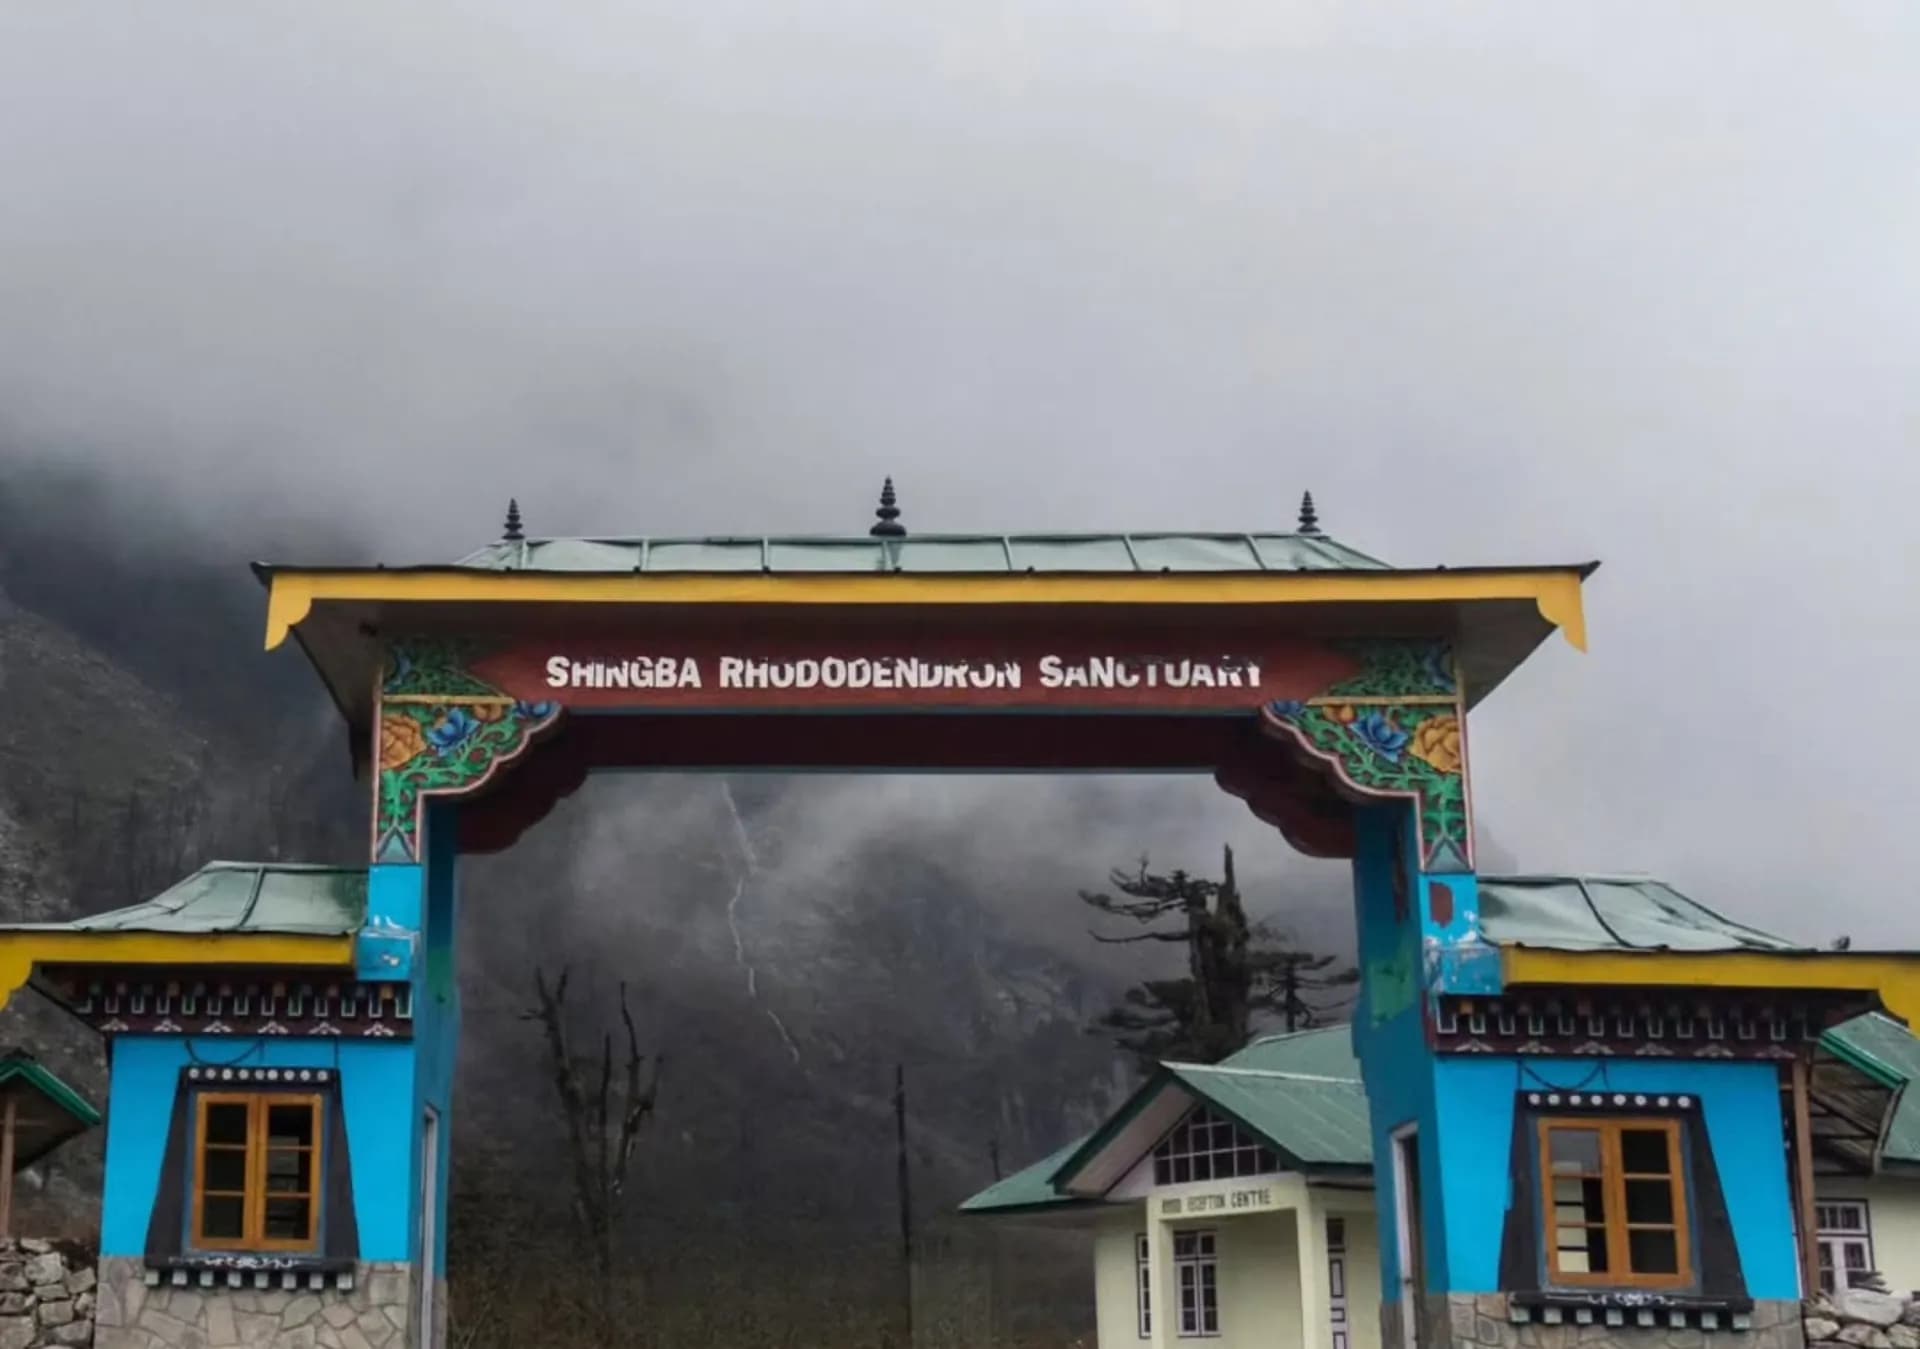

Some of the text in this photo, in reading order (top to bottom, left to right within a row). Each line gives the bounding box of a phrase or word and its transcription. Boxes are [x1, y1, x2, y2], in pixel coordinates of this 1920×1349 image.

[545, 655, 1262, 689] SHINGBA RHODODENDRON SANCTUARY
[1231, 1188, 1272, 1208] CENTRE
